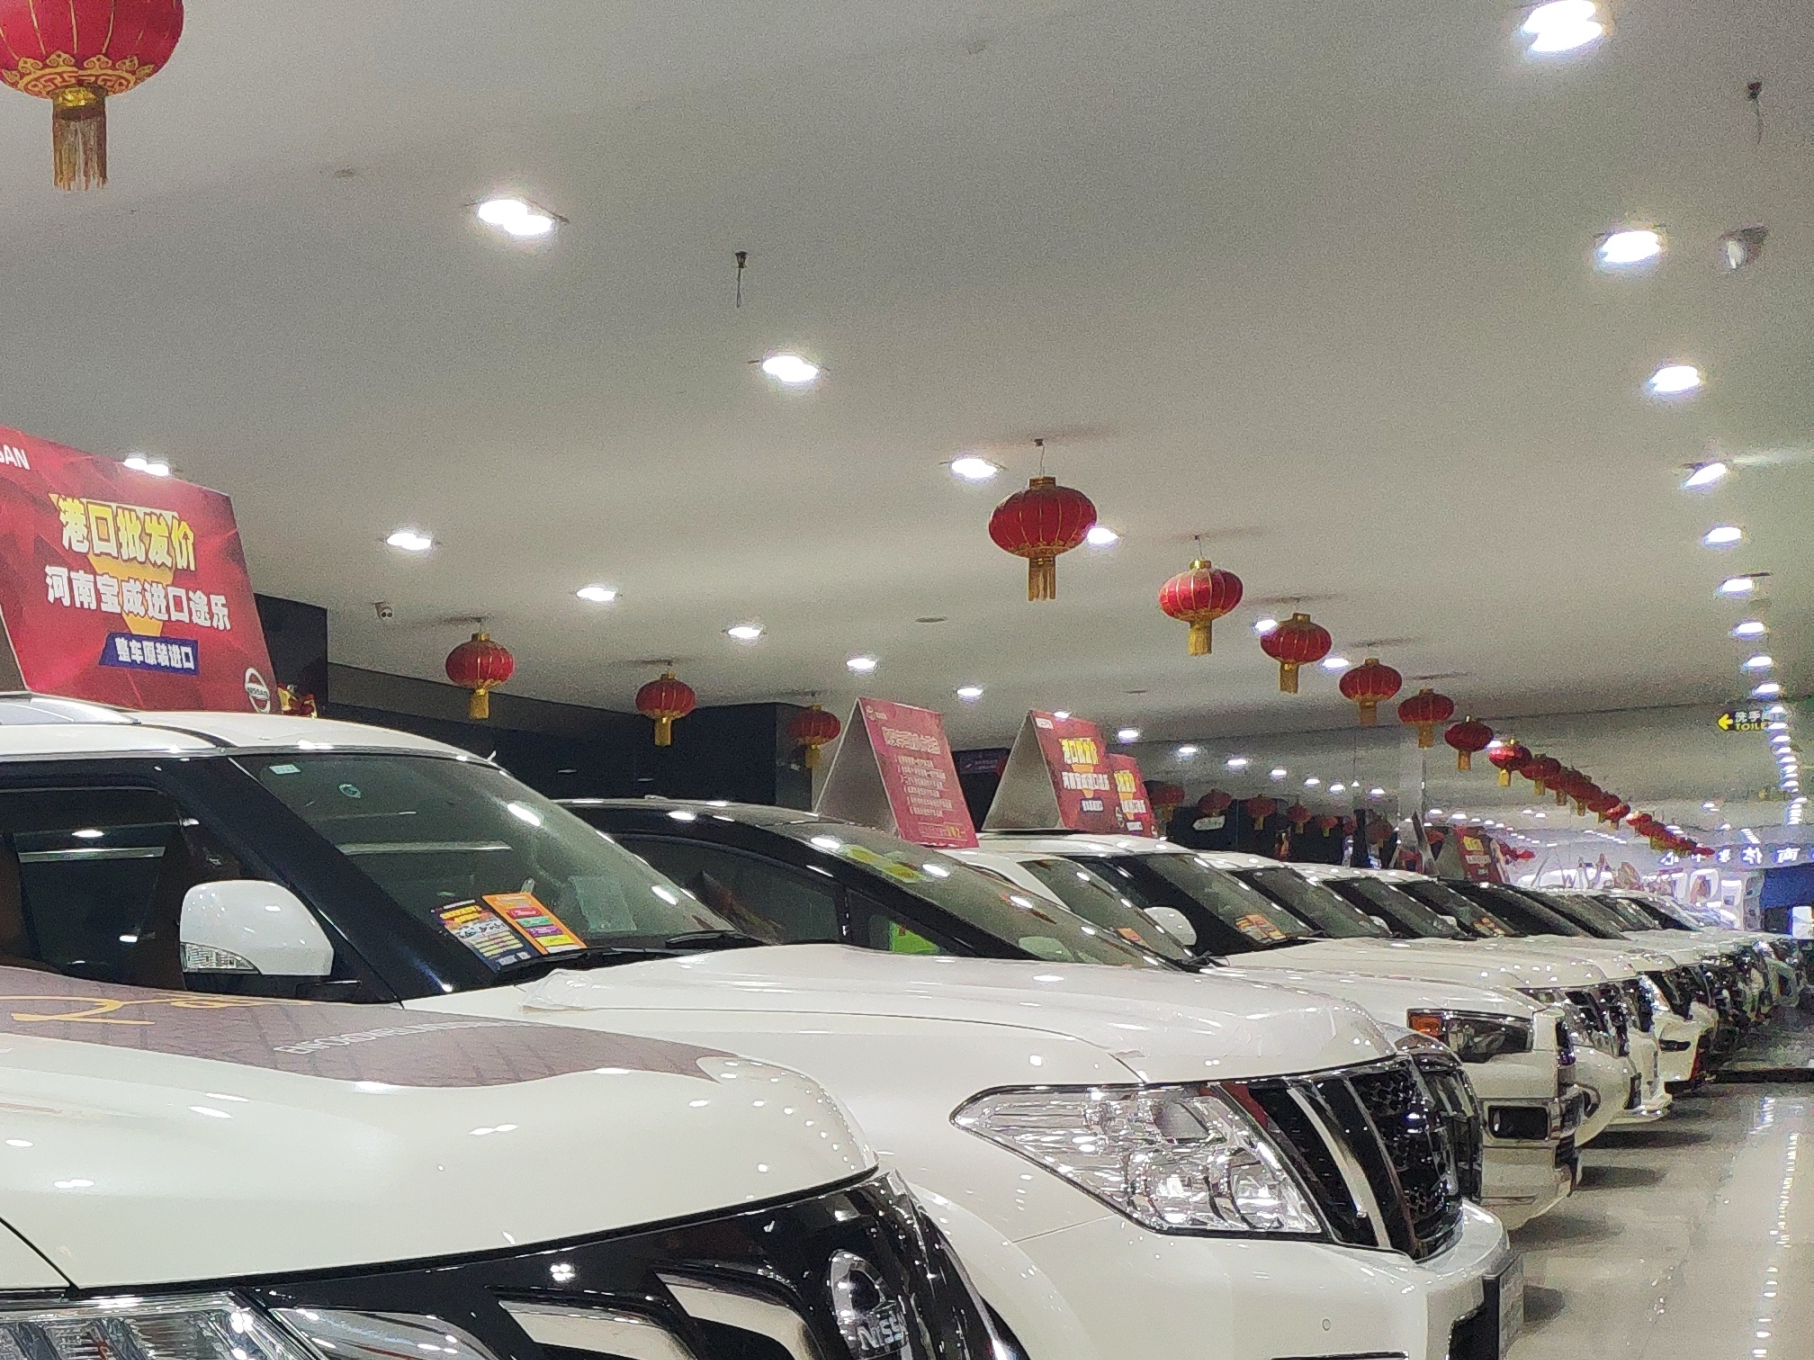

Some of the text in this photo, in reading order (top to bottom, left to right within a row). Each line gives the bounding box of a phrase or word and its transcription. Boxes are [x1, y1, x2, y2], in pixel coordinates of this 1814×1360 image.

[58, 496, 196, 571] 港口批发价
[45, 565, 231, 631] 河南宝成进口途乐
[1735, 722, 1772, 732] TOILE
